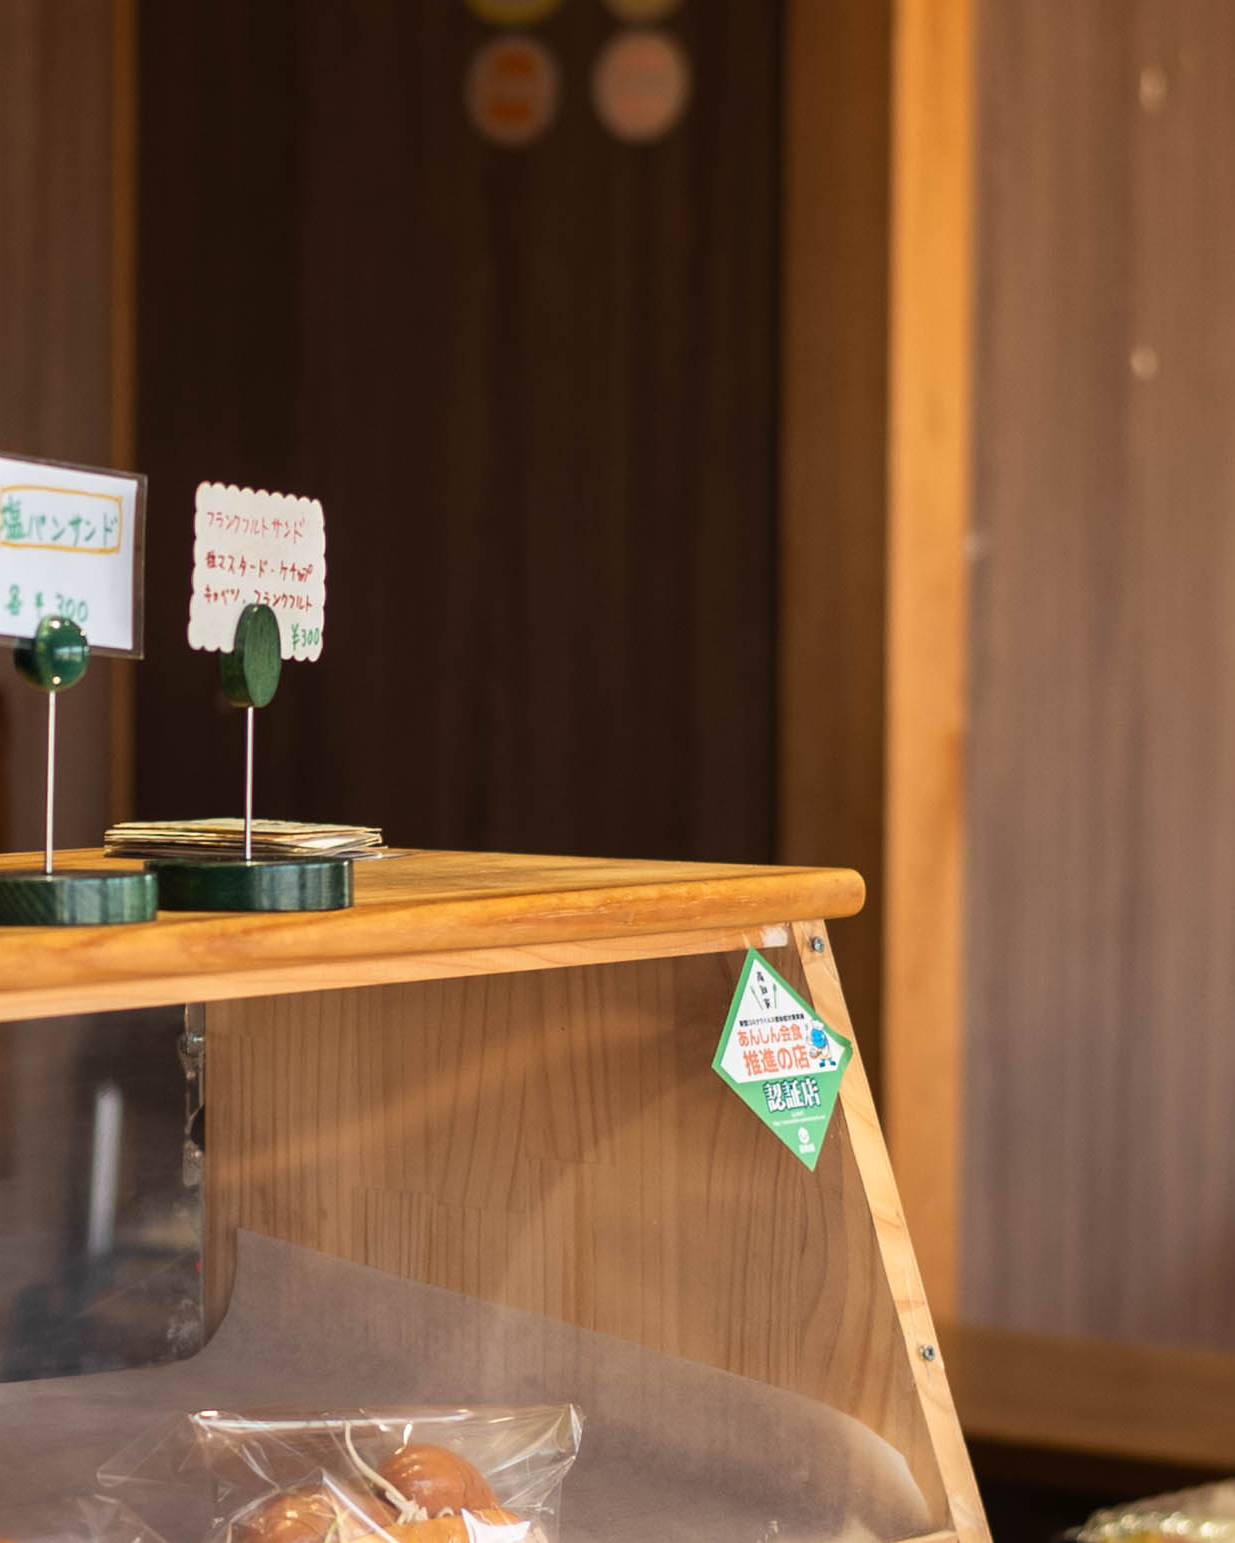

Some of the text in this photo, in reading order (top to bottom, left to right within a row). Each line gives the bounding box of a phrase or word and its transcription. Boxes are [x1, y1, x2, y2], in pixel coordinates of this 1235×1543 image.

[737, 1023, 803, 1047] あんしん会食
[743, 1045, 811, 1077] 推進の店
[763, 1077, 821, 1112] 認証店
